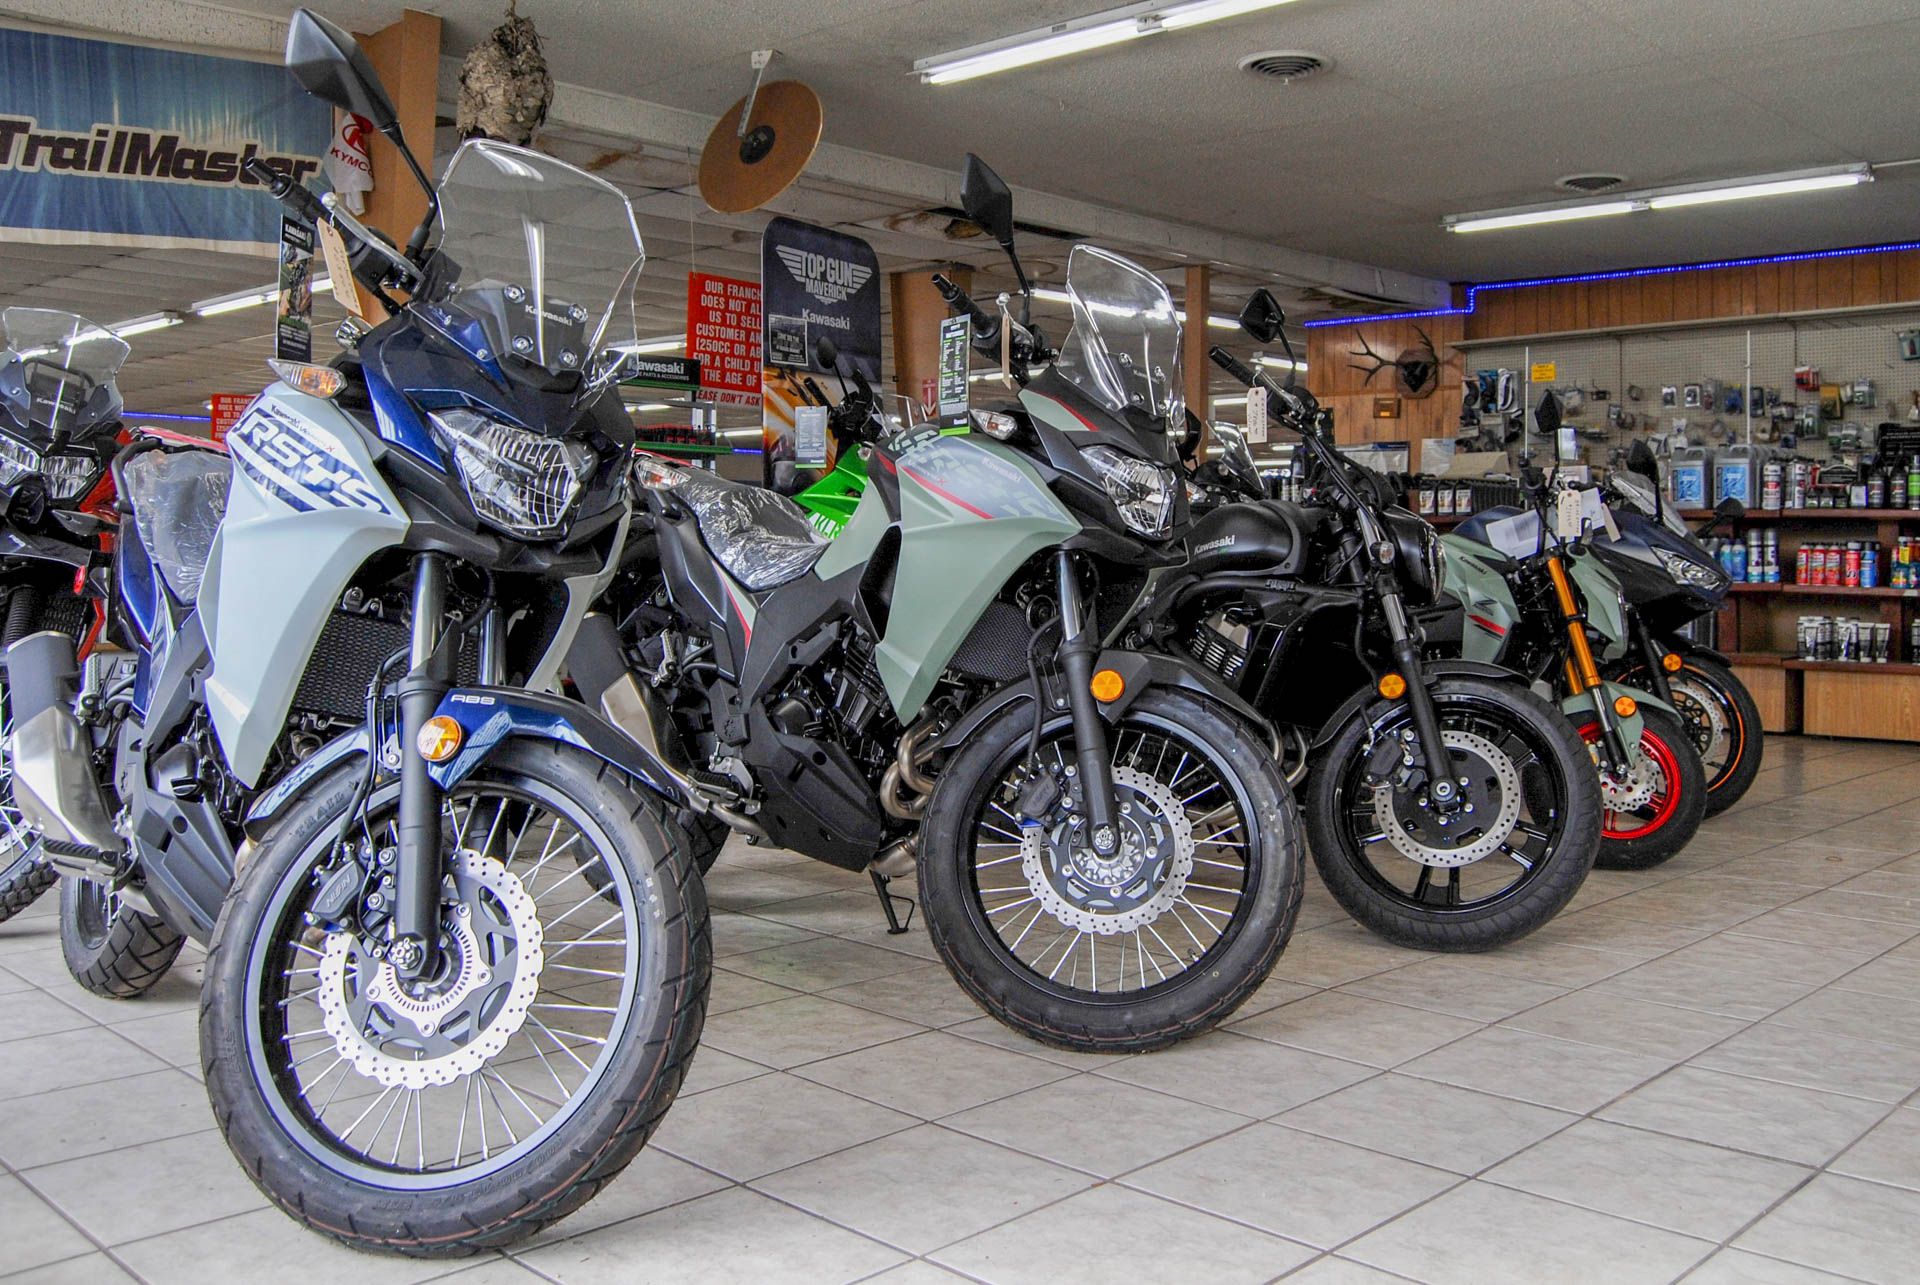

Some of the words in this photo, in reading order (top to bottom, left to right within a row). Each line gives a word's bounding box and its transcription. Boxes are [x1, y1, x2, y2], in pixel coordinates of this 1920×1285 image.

[801, 251, 826, 280] TOP
[826, 257, 854, 288] GUN
[704, 280, 724, 294] OUR
[805, 278, 848, 301] MAVERICK
[701, 294, 725, 309] DOES
[728, 299, 747, 312] NOT
[709, 310, 722, 323] US
[725, 312, 737, 326] TO
[740, 315, 761, 329] SELL
[802, 308, 850, 331] Kawasaki
[696, 322, 746, 342] CUSTOMER
[696, 336, 731, 354] (250CC
[734, 343, 746, 356] OR
[693, 352, 711, 366] FOR
[715, 355, 721, 368] A
[724, 356, 751, 372] CHILD
[704, 368, 721, 383] THE
[725, 372, 743, 385] AGE
[746, 374, 757, 387] OF
[37, 397, 76, 415] Kawsaki
[721, 392, 743, 404] DON'T
[745, 395, 760, 407] ASK
[450, 694, 495, 706] ABS
